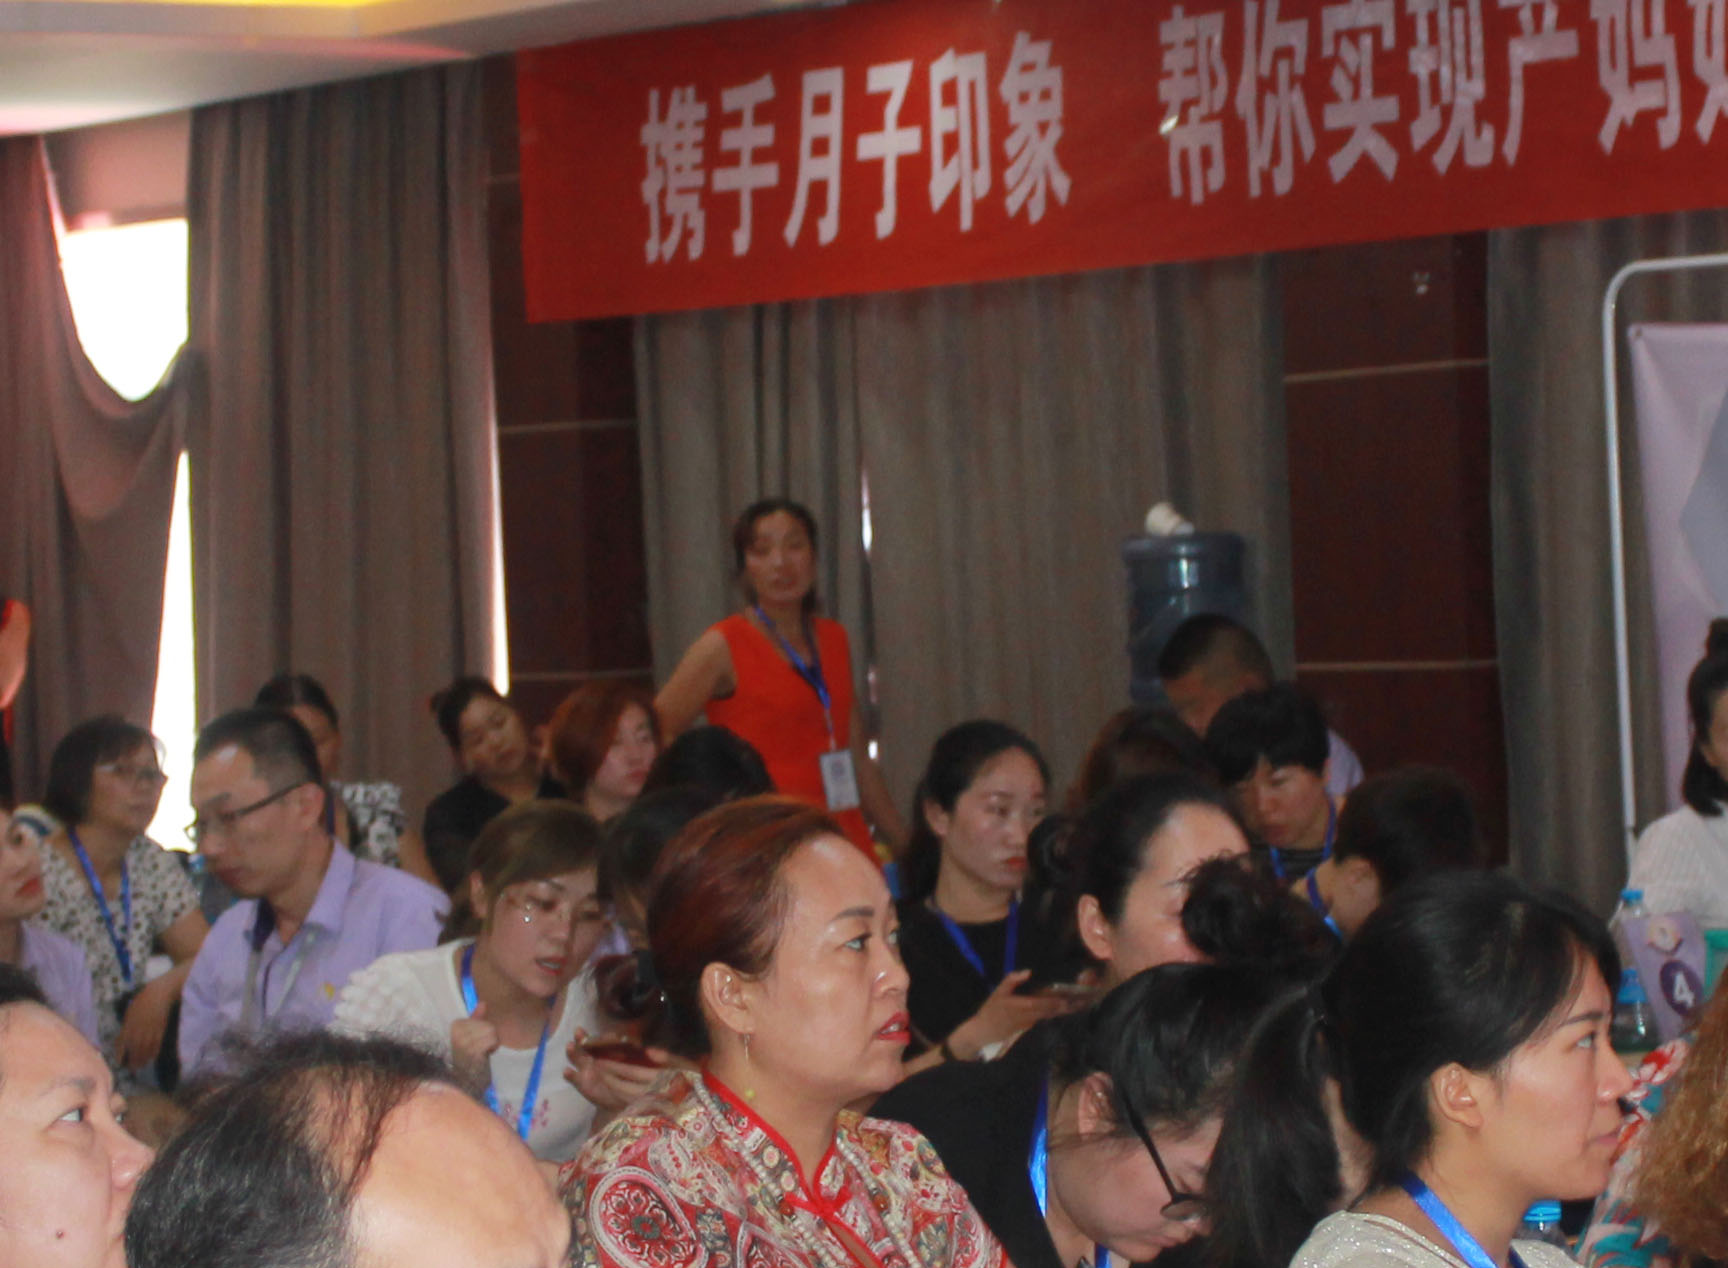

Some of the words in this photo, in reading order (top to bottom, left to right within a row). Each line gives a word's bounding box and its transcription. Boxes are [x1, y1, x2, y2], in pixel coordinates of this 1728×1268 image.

[640, 30, 1071, 266] 携手月子印象
[1673, 971, 1695, 1008] 4
